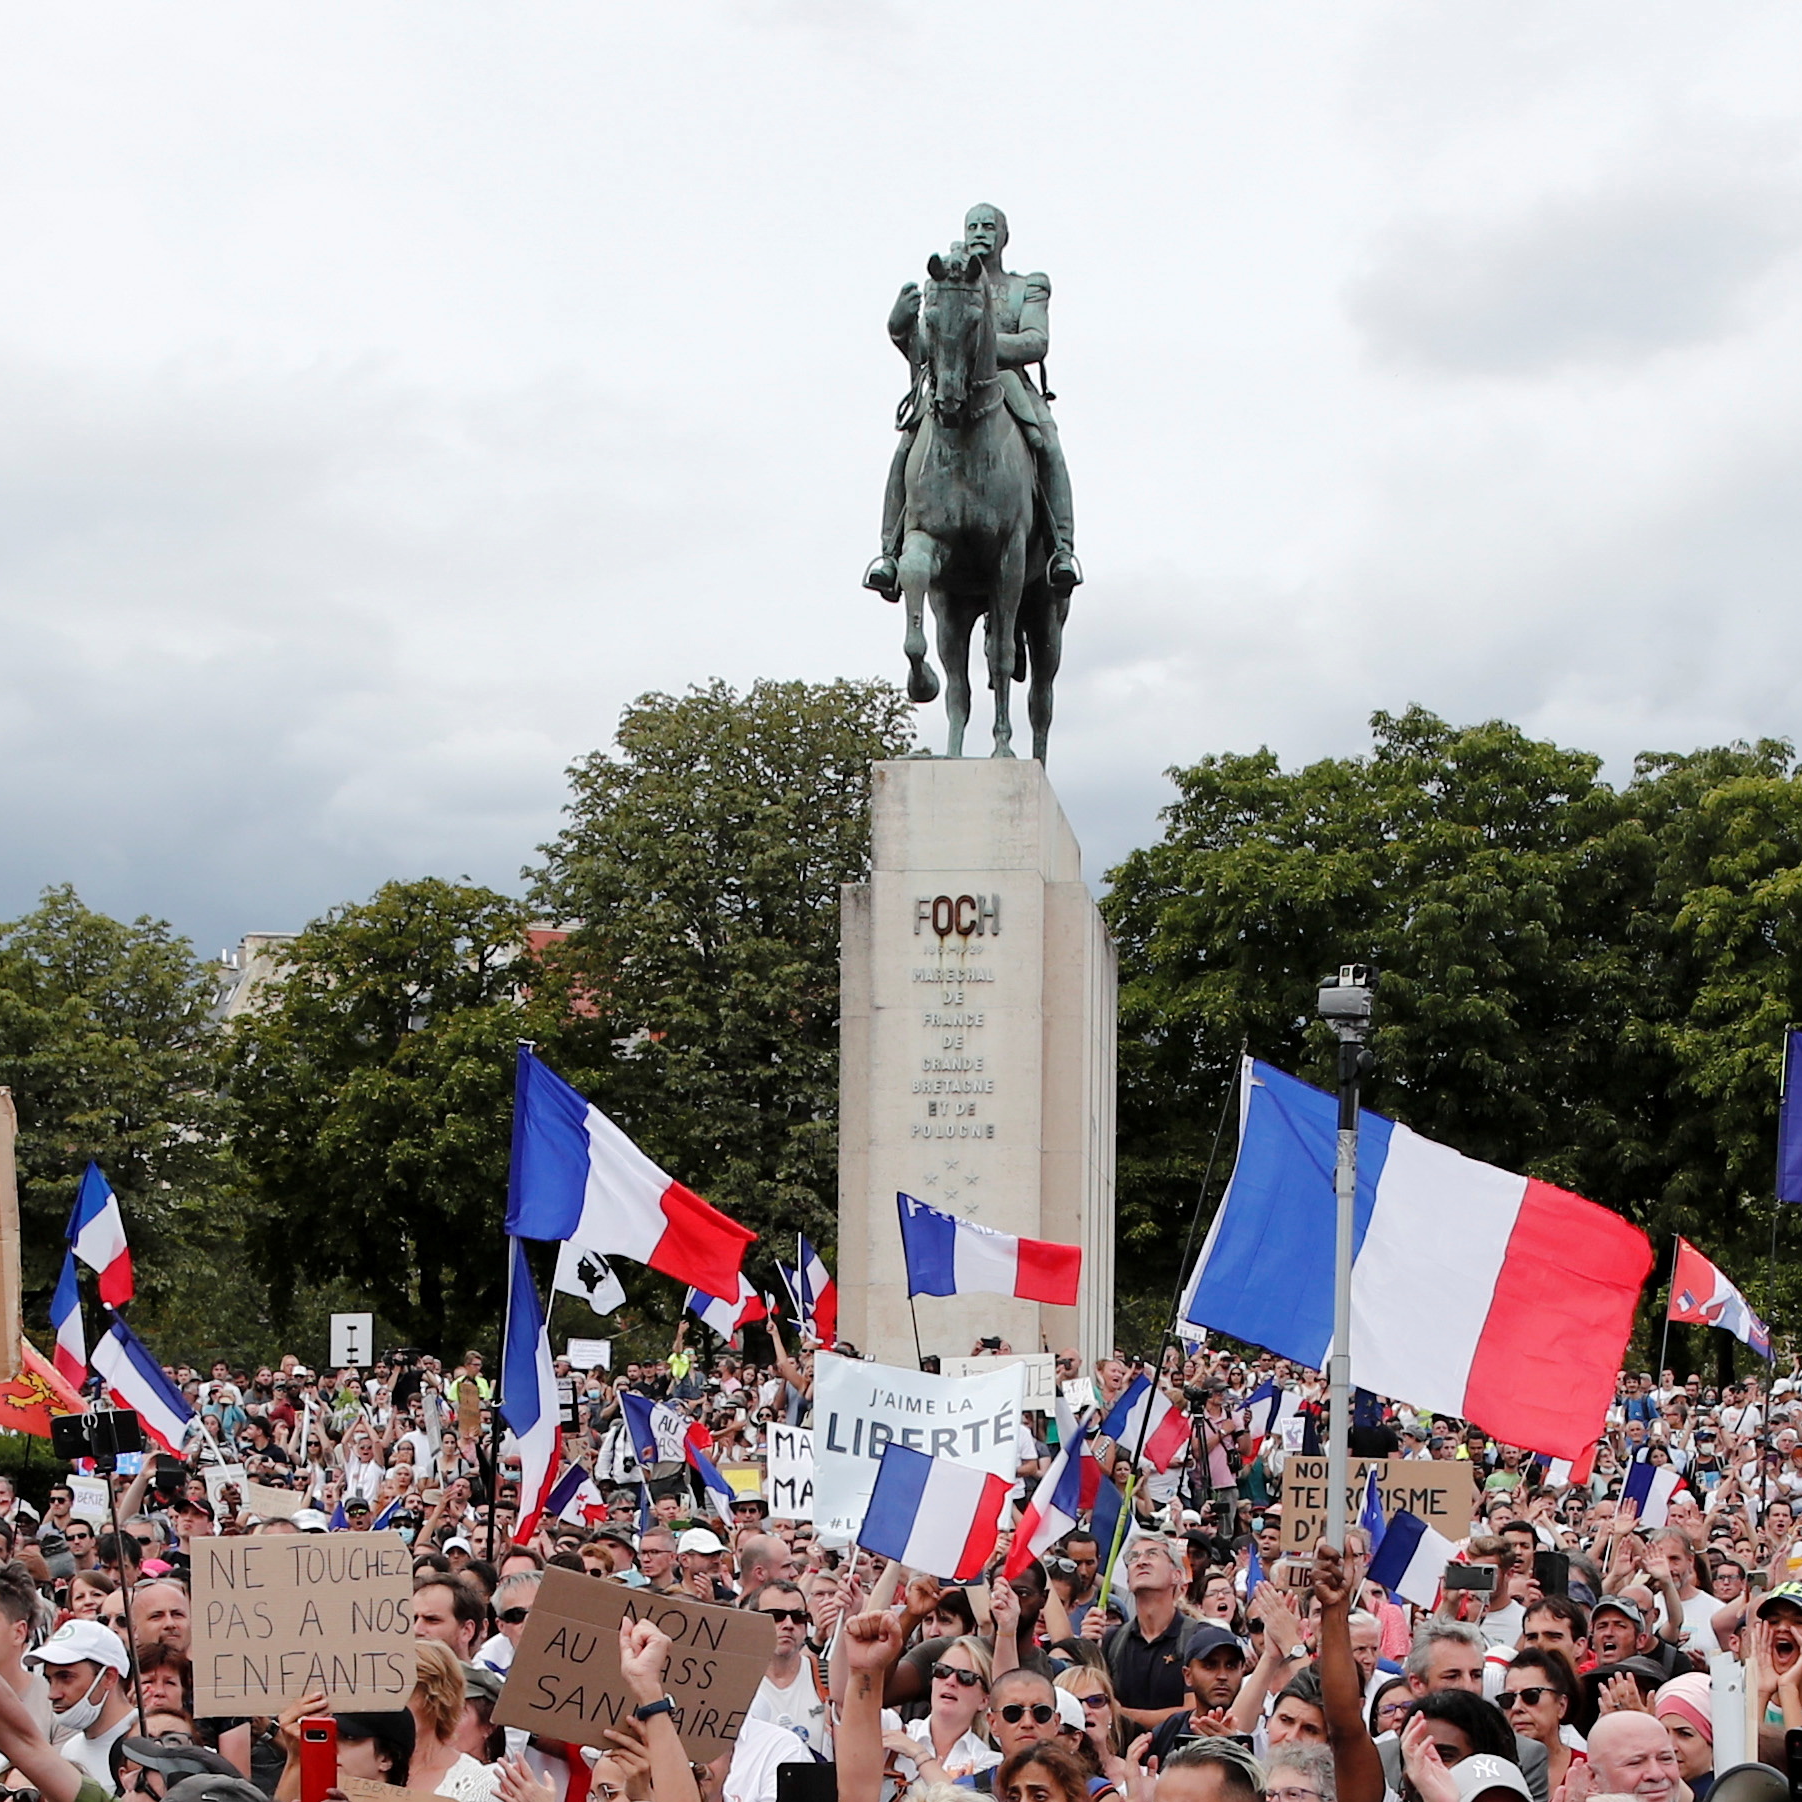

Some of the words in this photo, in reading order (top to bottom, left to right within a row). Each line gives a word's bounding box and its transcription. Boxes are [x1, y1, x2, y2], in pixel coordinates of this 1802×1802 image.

[914, 893, 1001, 936] FOCH
[943, 991, 964, 1005] DE
[922, 1013, 984, 1027] FRANCE
[942, 1036, 964, 1050] DE
[921, 1057, 984, 1072] GRANDE
[912, 1079, 994, 1094] BRETAGNE
[928, 1101, 948, 1116] ET
[955, 1102, 976, 1117] DE
[911, 1124, 995, 1139] POLOGNE
[869, 1388, 936, 1415] J'AIME
[947, 1398, 974, 1415] LA
[1295, 1462, 1329, 1480] NO
[210, 1547, 265, 1589] NE
[286, 1545, 409, 1587] TOUCHEZ
[207, 1600, 273, 1639] PAS
[299, 1600, 324, 1636] A
[352, 1598, 411, 1635] NOS
[544, 1626, 597, 1664] AU
[660, 1654, 717, 1690] ASS
[214, 1651, 405, 1698] ENFANTS
